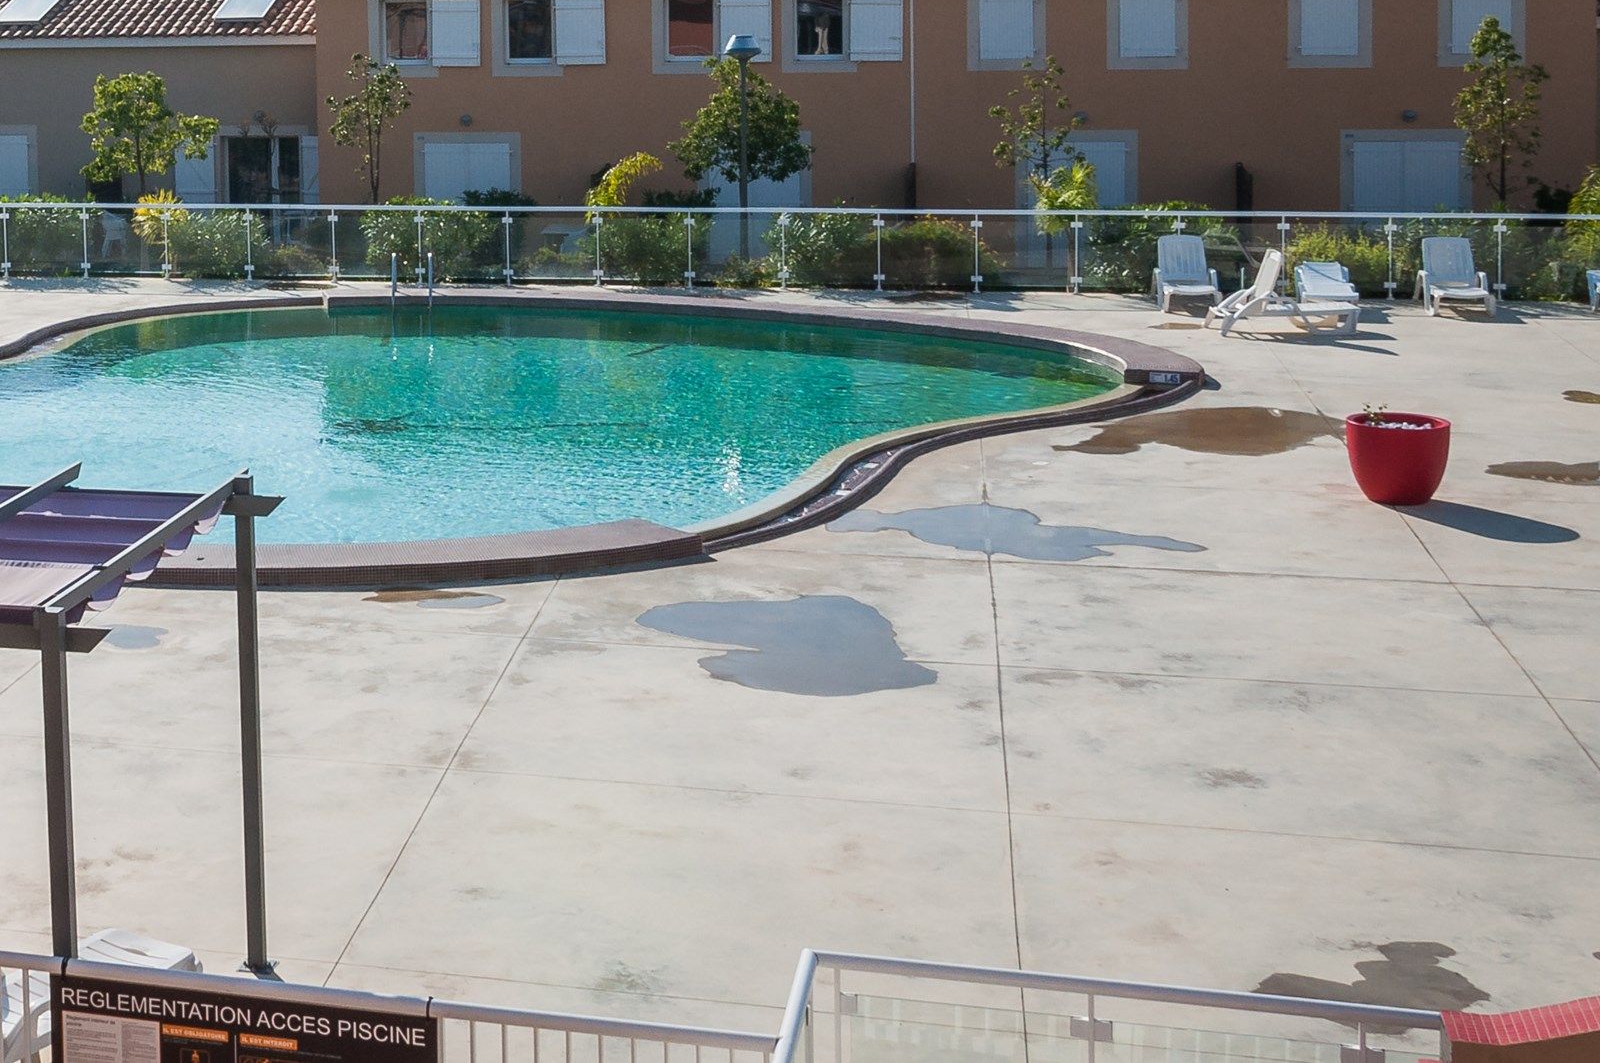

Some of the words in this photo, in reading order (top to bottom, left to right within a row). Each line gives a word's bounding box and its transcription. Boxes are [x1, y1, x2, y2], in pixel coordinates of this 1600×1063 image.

[61, 987, 251, 1026] REGLEMENTATION
[256, 1011, 331, 1036] ACCES
[338, 1020, 426, 1047] PISCINE
[261, 1040, 293, 1048] INTERDIT
